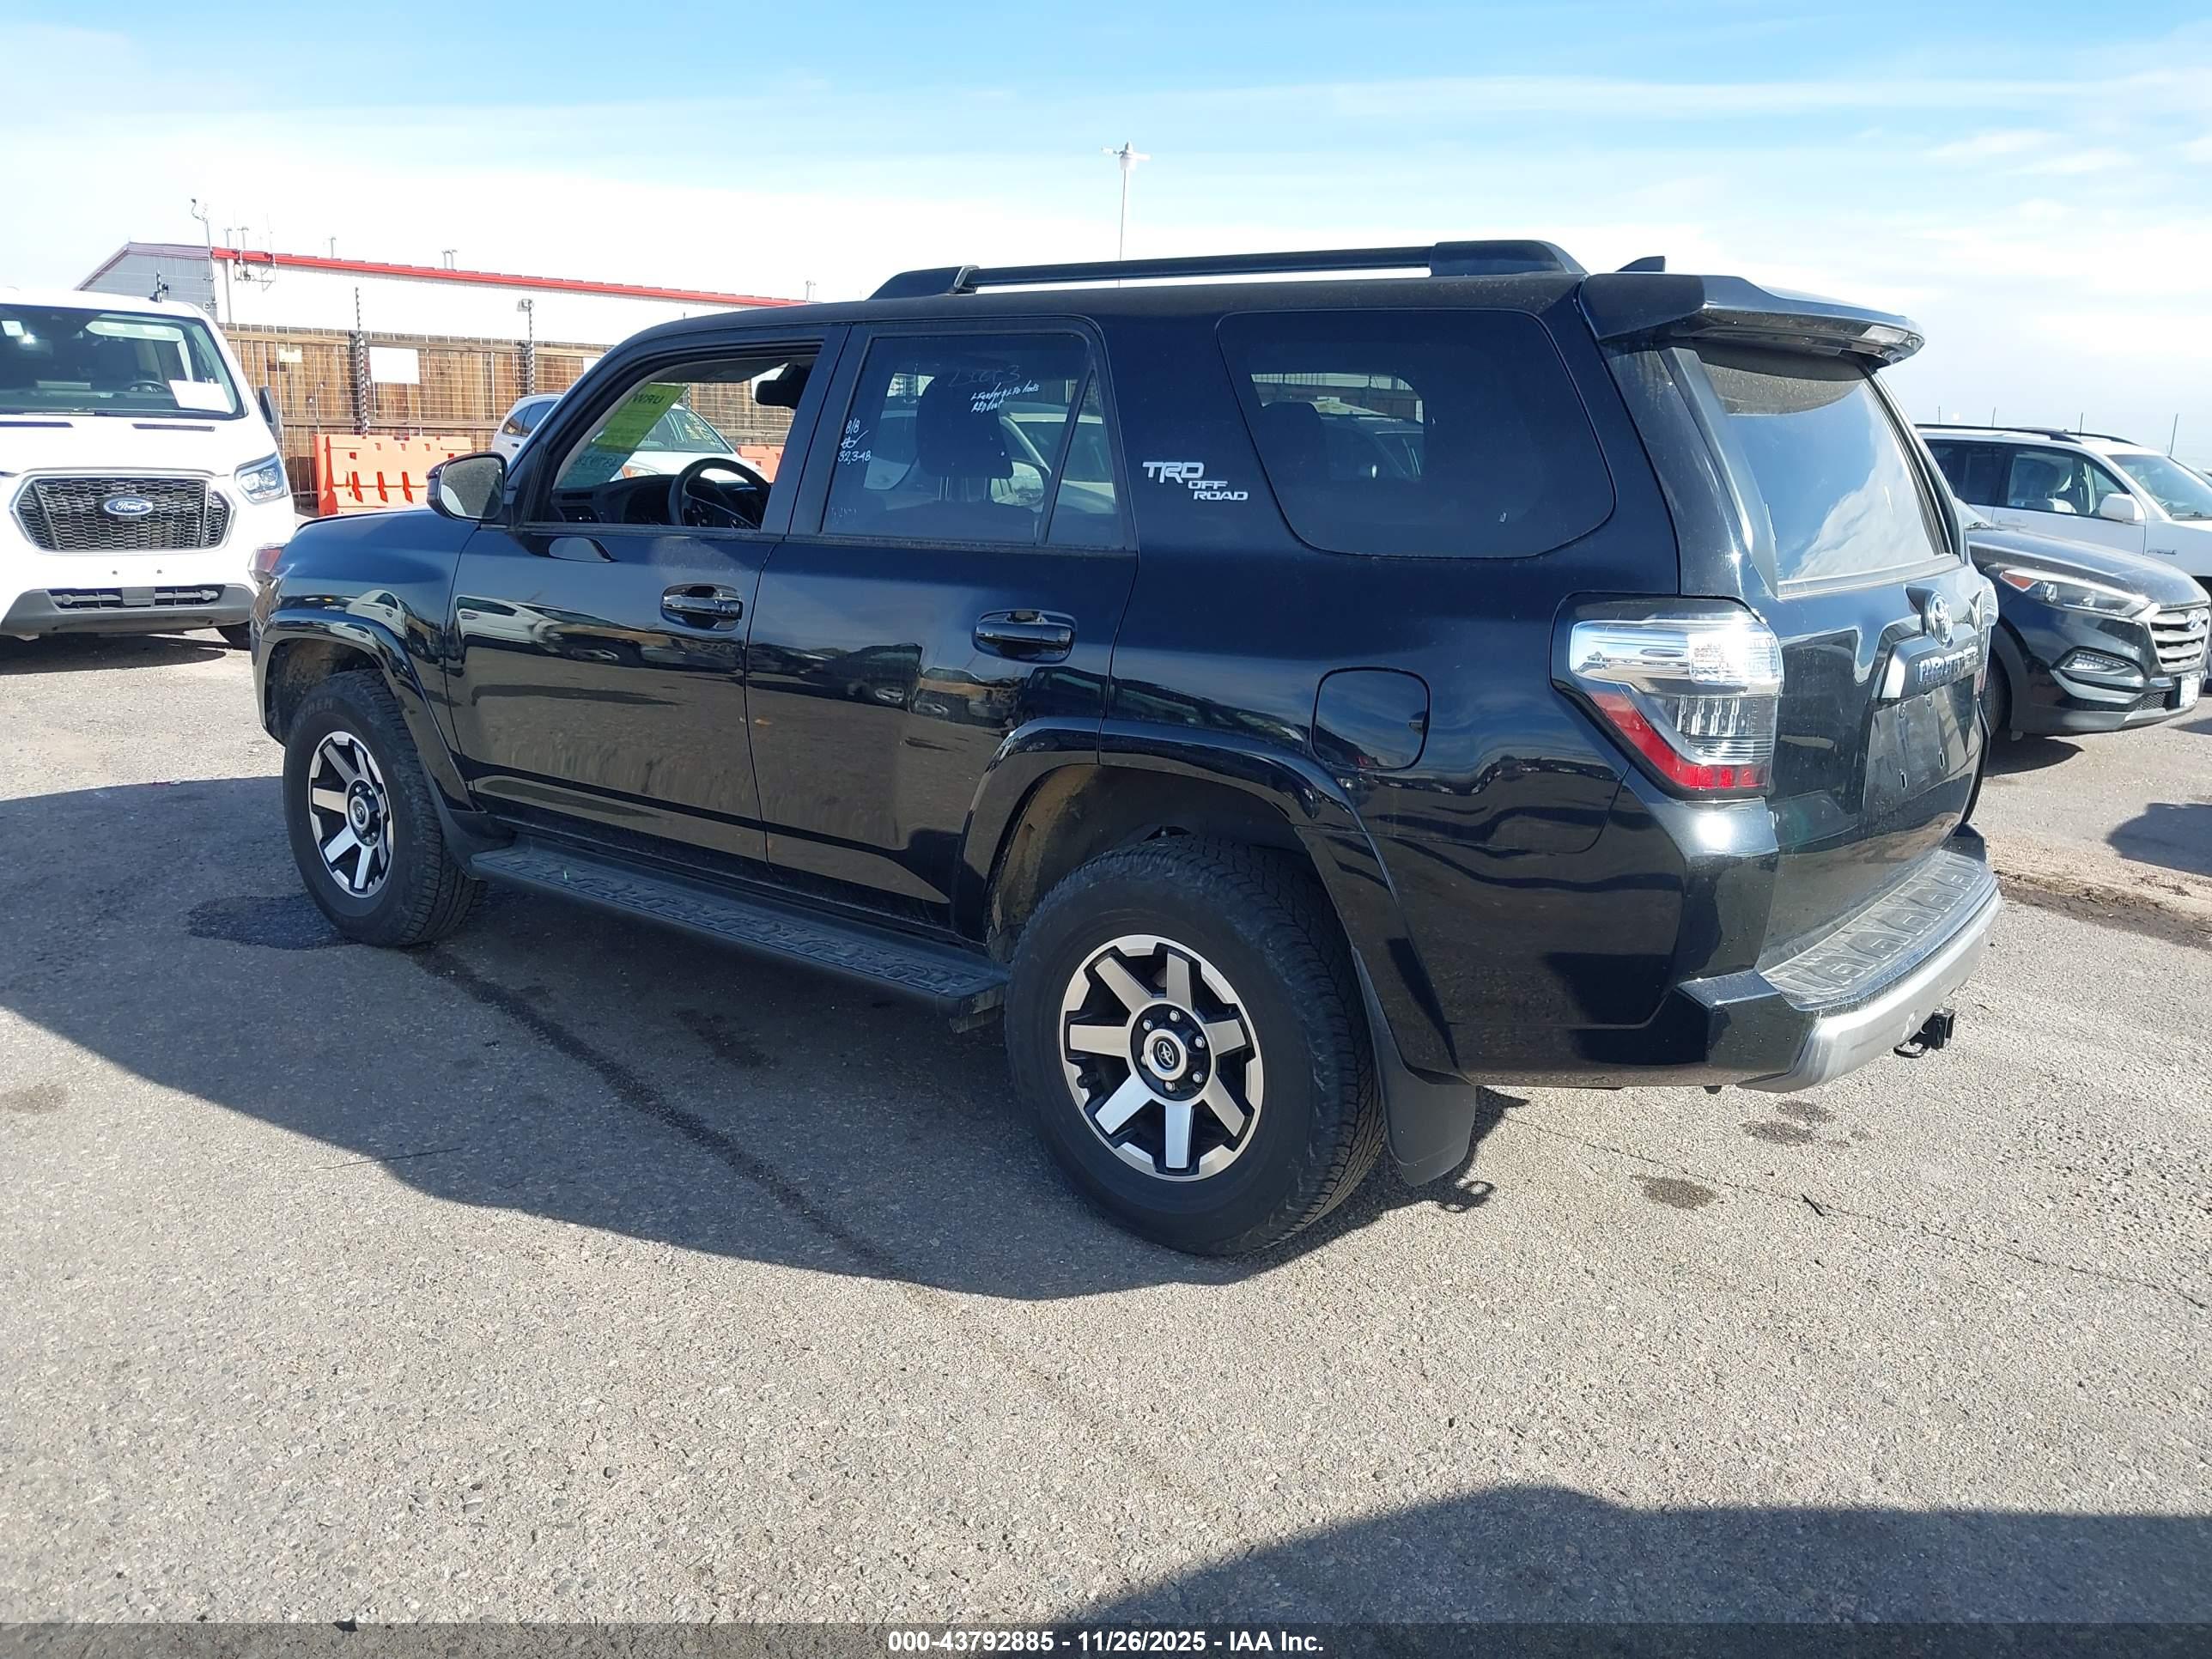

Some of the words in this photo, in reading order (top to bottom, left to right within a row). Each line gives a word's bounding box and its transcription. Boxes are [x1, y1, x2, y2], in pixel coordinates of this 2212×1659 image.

[1142, 462, 1204, 483] TRD
[1188, 481, 1228, 489] OFF
[1194, 491, 1249, 501] ROAD
[115, 501, 143, 511] Ford
